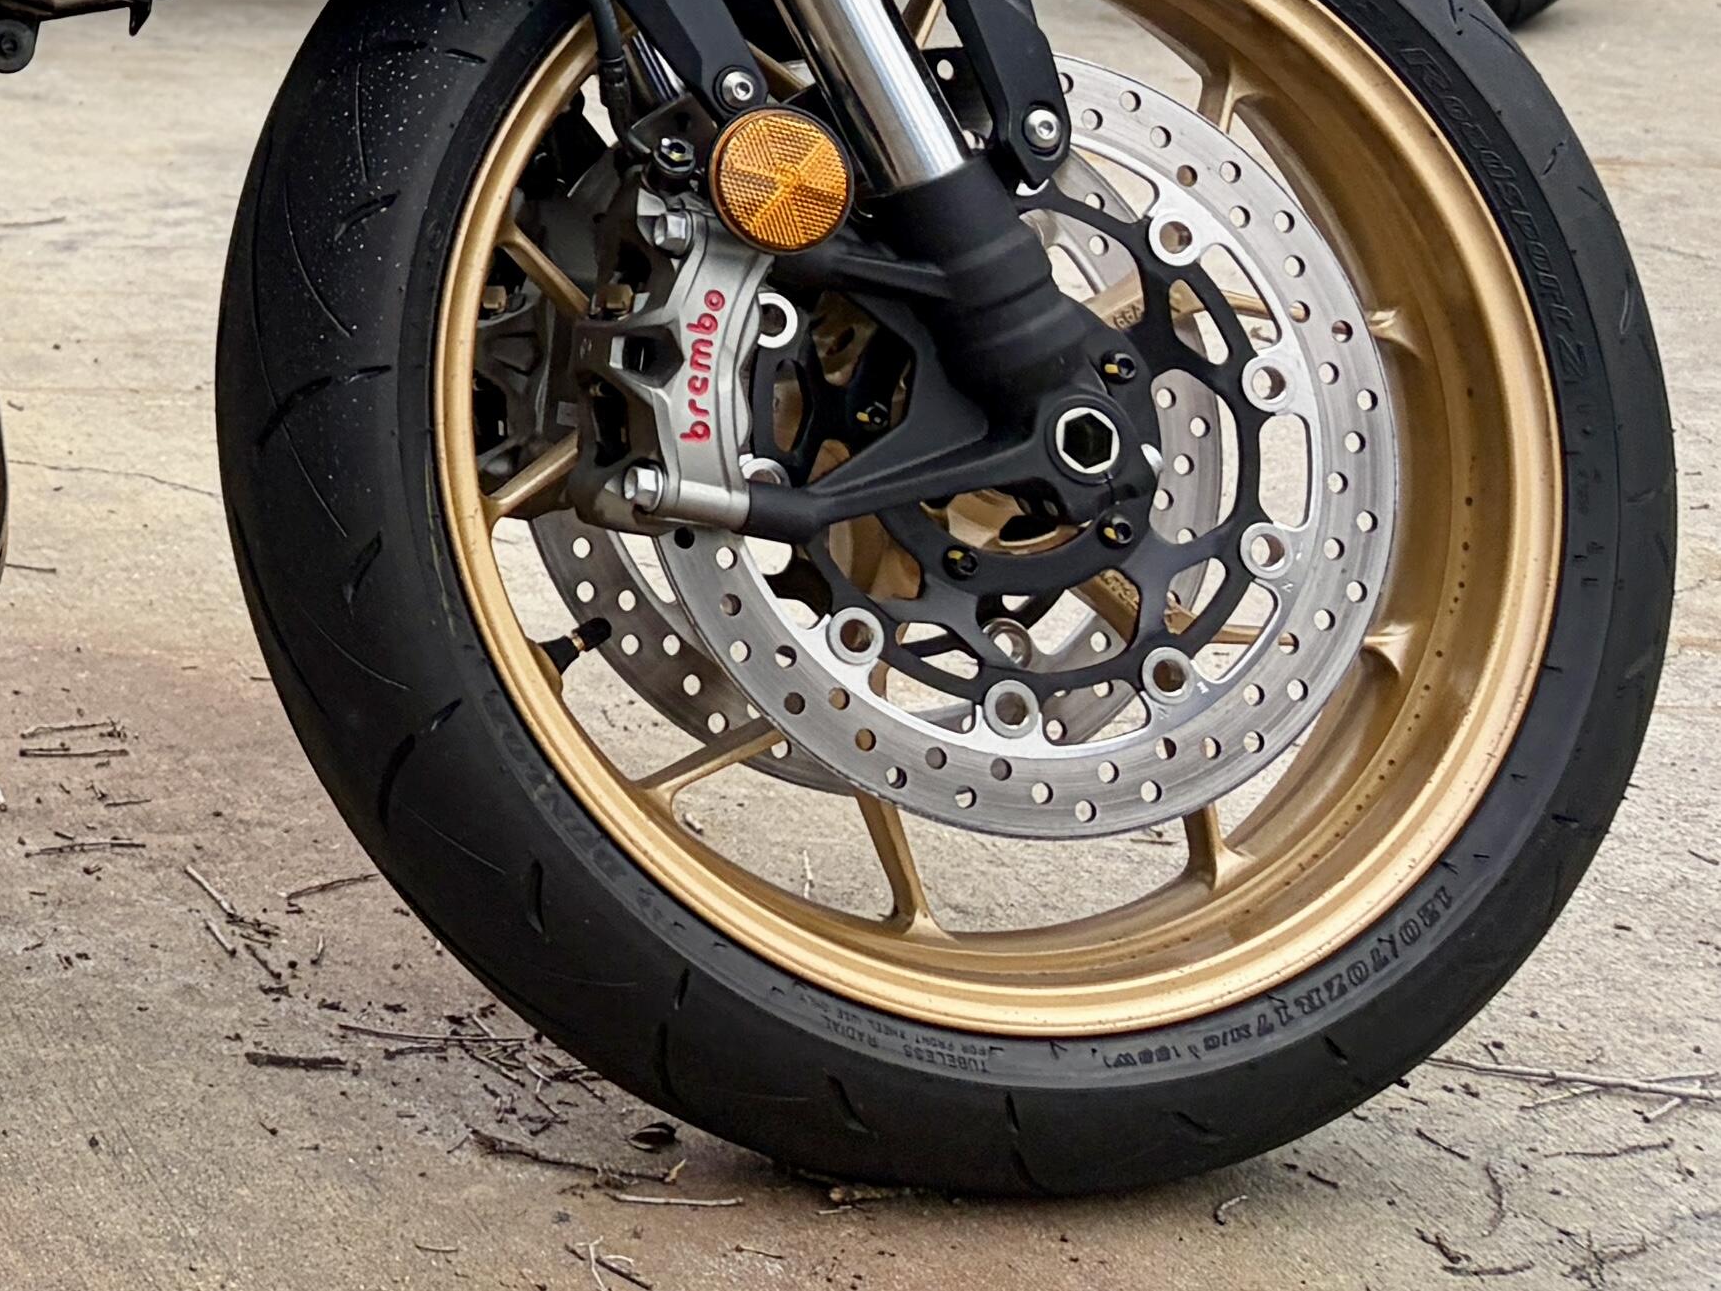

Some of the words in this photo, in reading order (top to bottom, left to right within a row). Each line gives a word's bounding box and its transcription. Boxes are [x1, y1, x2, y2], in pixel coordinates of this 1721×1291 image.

[681, 289, 726, 443] brembo
[821, 1015, 879, 1049] RADIAL
[903, 1043, 989, 1073] TUBELESS
